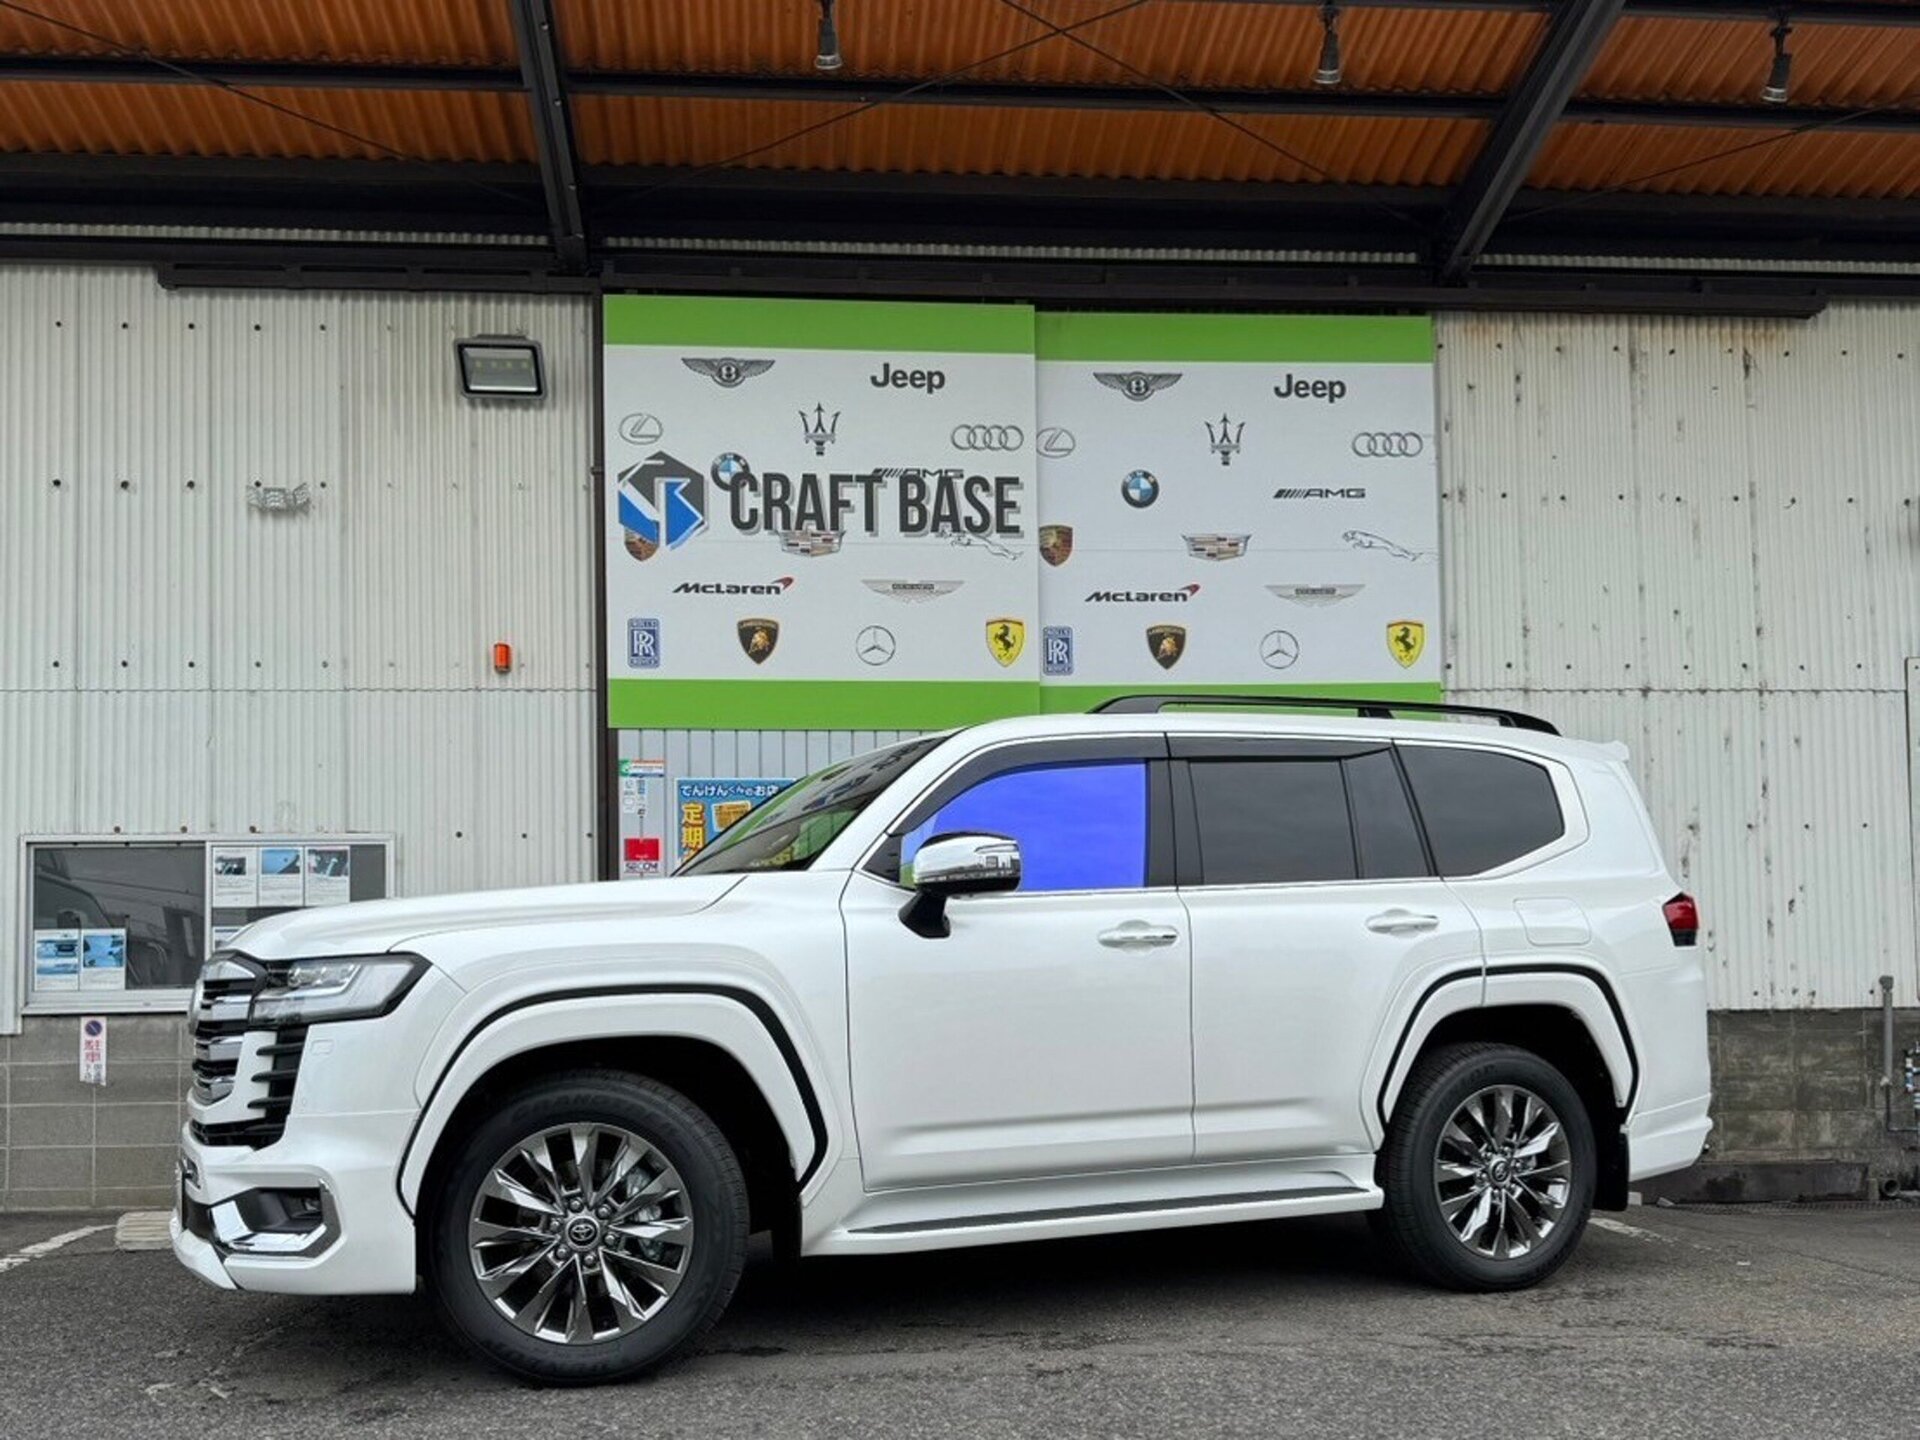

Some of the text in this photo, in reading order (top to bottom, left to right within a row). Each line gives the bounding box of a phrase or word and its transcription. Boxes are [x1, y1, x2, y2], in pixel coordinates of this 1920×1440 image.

[870, 362, 946, 394] Jeep
[1274, 373, 1347, 403] Jeep
[729, 472, 1021, 534] CRAFT BASE
[1303, 488, 1366, 499] AMG
[673, 582, 781, 595] McLaren
[1085, 591, 1188, 602] McLaren
